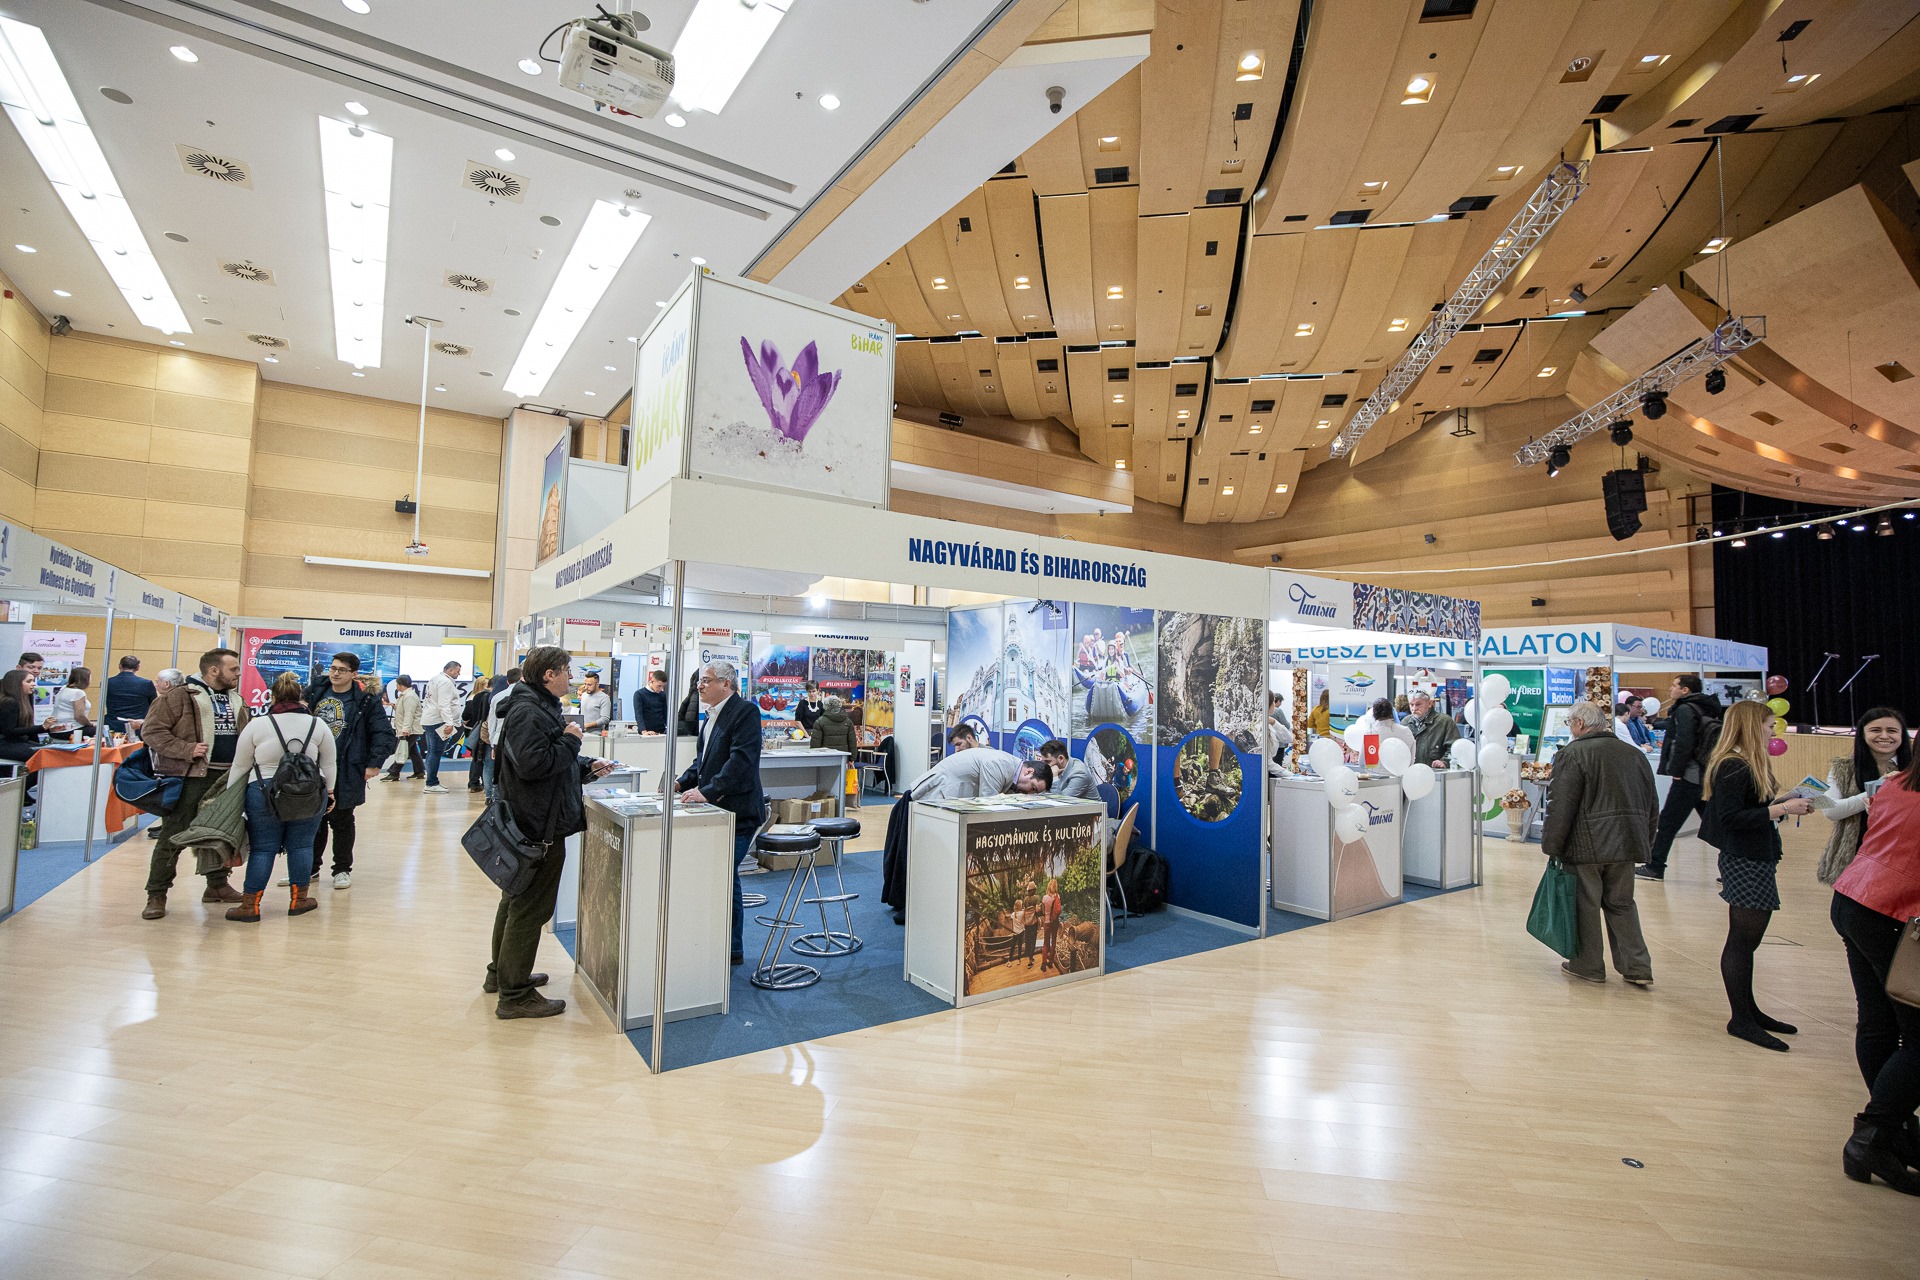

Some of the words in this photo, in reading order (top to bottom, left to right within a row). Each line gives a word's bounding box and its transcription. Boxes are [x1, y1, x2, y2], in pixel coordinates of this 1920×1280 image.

[908, 537, 1016, 573] NAGYVÁRAD
[1020, 547, 1040, 576] ÉS
[1043, 554, 1147, 588] BIHARORSZÁG
[40, 567, 65, 590] Wellness
[64, 575, 71, 591] és
[1288, 582, 1337, 618] Tunisia
[339, 627, 375, 639] Campus
[376, 629, 412, 640] Fesztivál
[1650, 634, 1683, 660] EGÉSZ
[1685, 637, 1713, 663] ÉVBEN
[1715, 645, 1747, 668] BALATON
[1551, 691, 1573, 704] Balaton
[975, 827, 1039, 850] HAGYOMÁNYOK
[1042, 824, 1052, 842] ÉS
[1055, 822, 1091, 841] KULTÚRA
